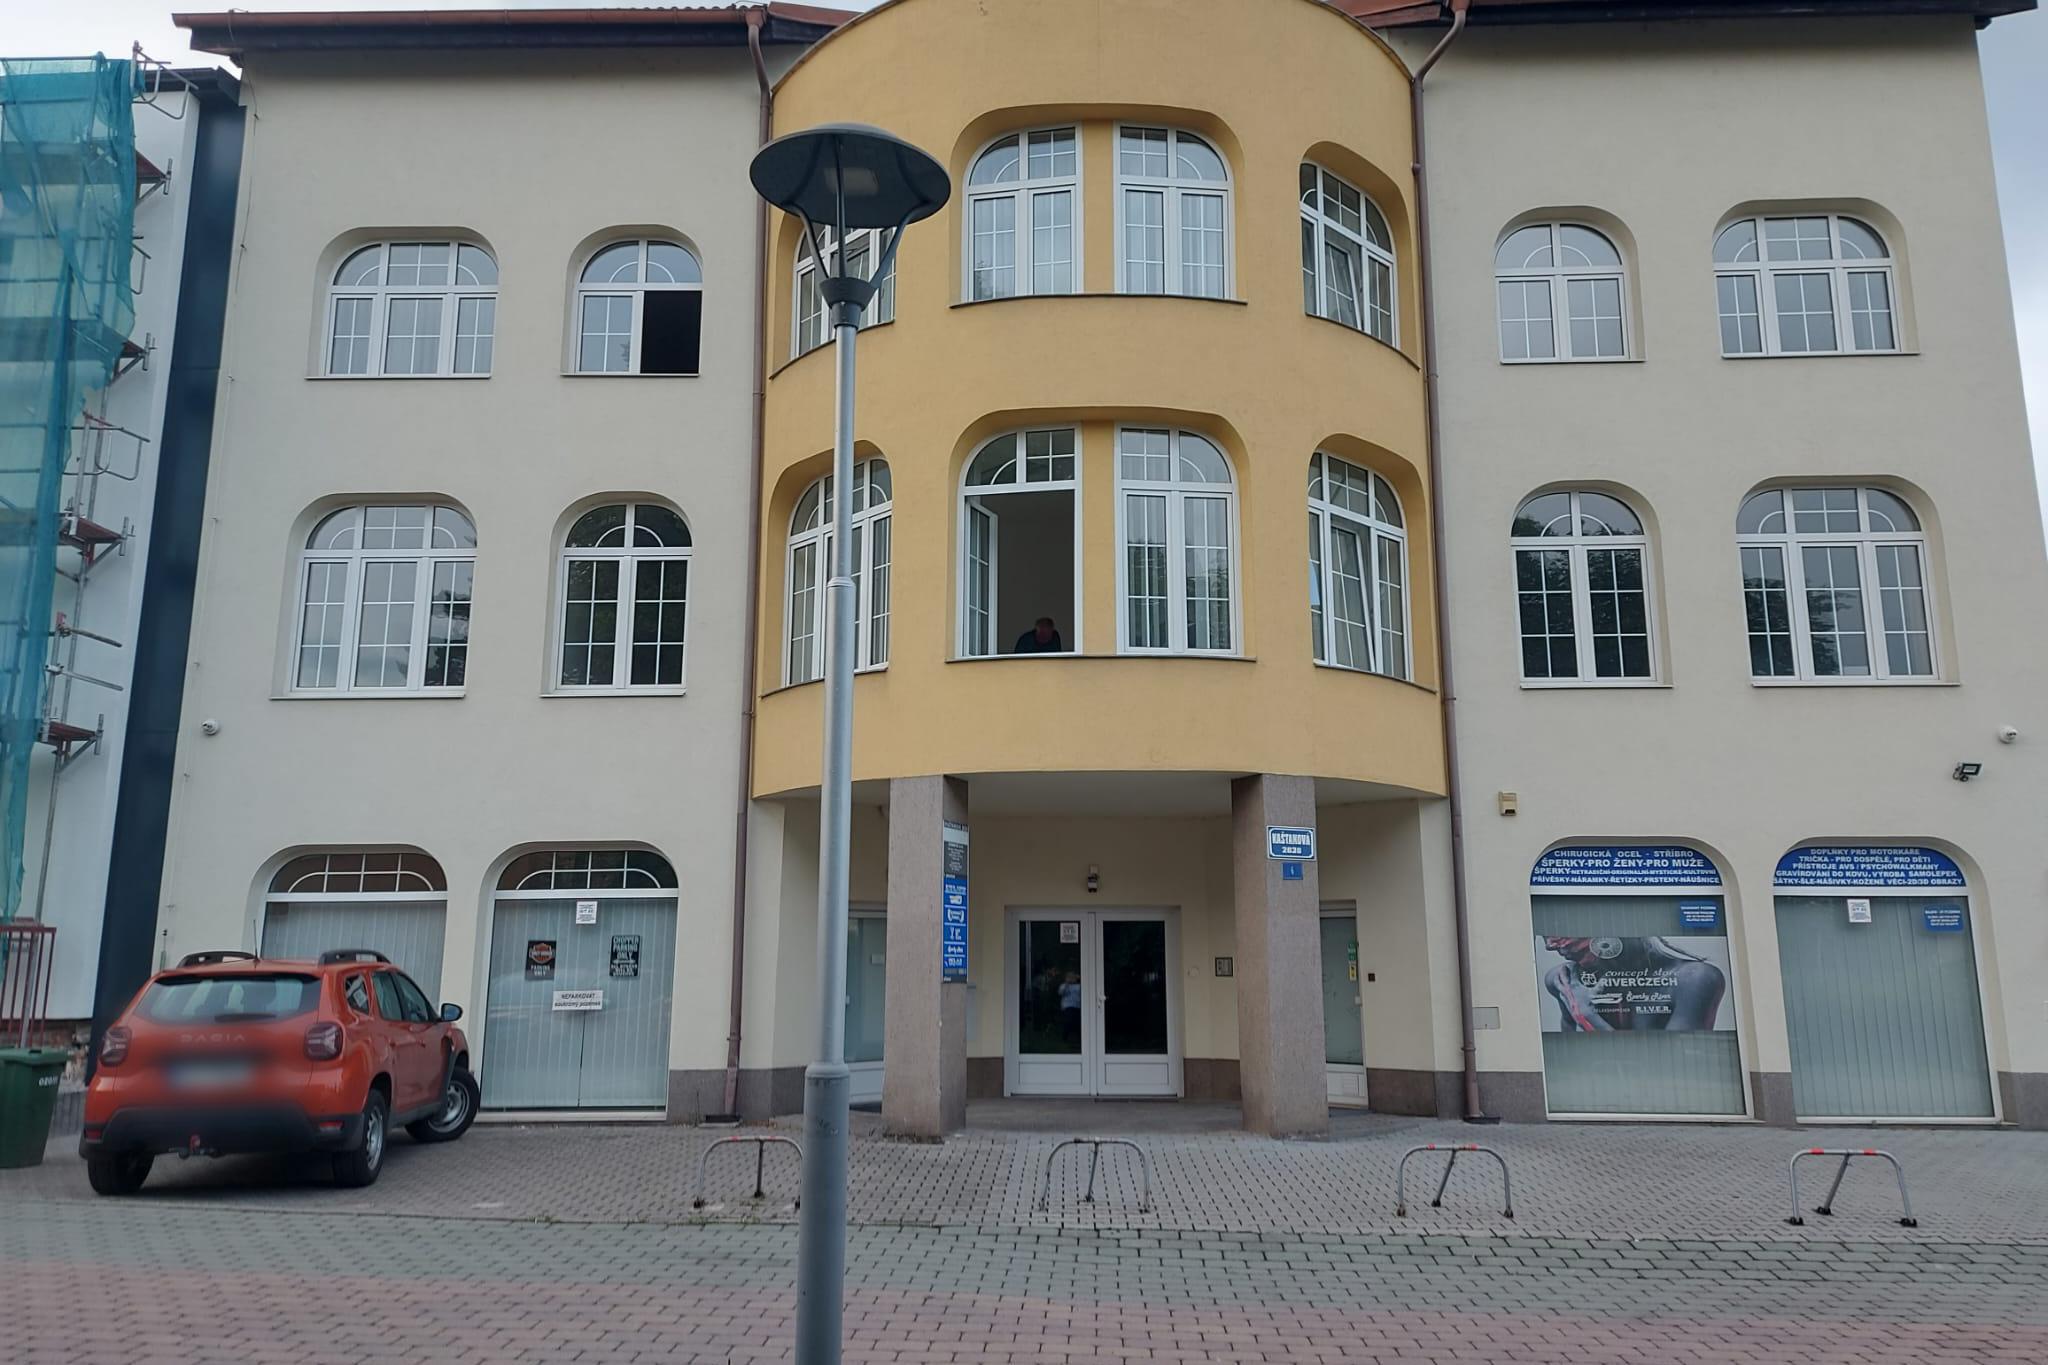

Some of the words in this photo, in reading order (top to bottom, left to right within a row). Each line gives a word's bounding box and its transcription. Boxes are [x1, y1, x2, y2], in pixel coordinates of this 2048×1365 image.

[1554, 848, 1612, 857] CHIRUGICKÁ
[1617, 850, 1642, 858] OCEL
[1653, 848, 1694, 858] STŘÍBRO
[1605, 967, 1649, 979] concept
[180, 1033, 247, 1043] DACIA
